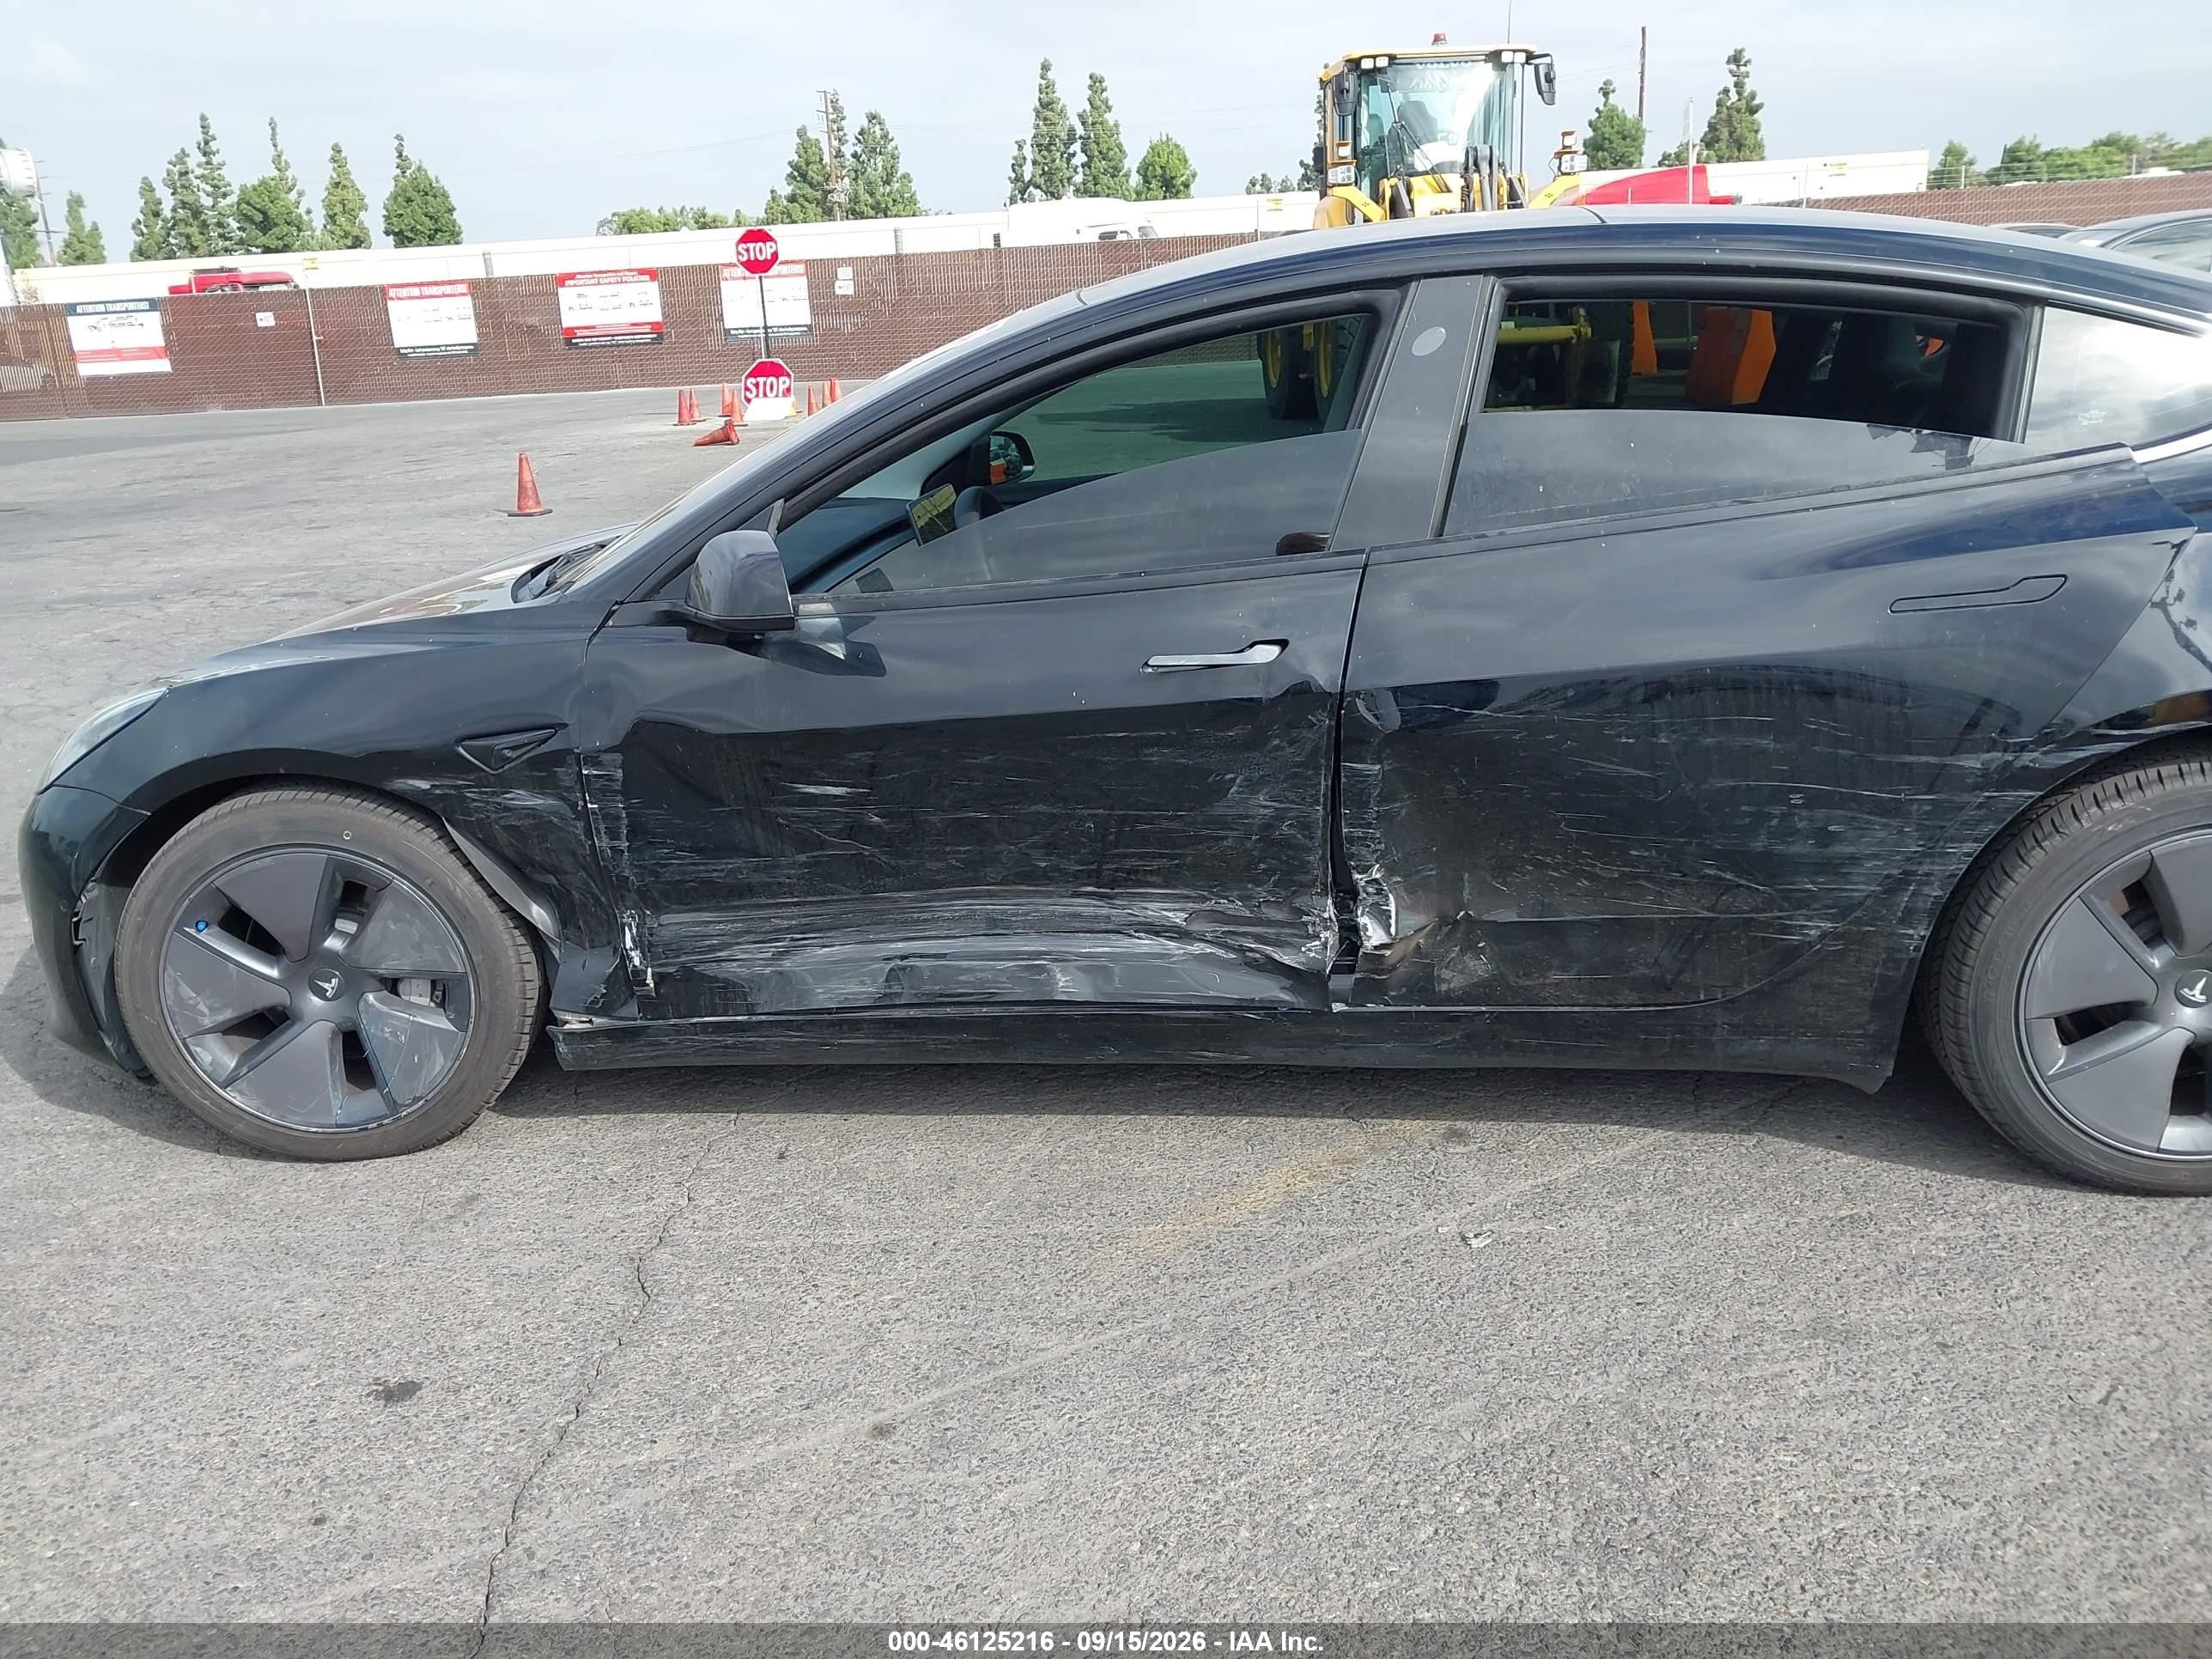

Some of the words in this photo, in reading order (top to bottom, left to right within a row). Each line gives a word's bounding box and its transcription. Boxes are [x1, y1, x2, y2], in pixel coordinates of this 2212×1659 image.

[738, 242, 776, 262] STOP
[565, 277, 599, 287] IMPORTANT
[599, 276, 621, 284] SAFETY
[622, 274, 650, 283] POLICIES
[387, 288, 420, 298] ATTENTION
[76, 304, 106, 313] ATTENTION
[745, 377, 790, 398] STOP
